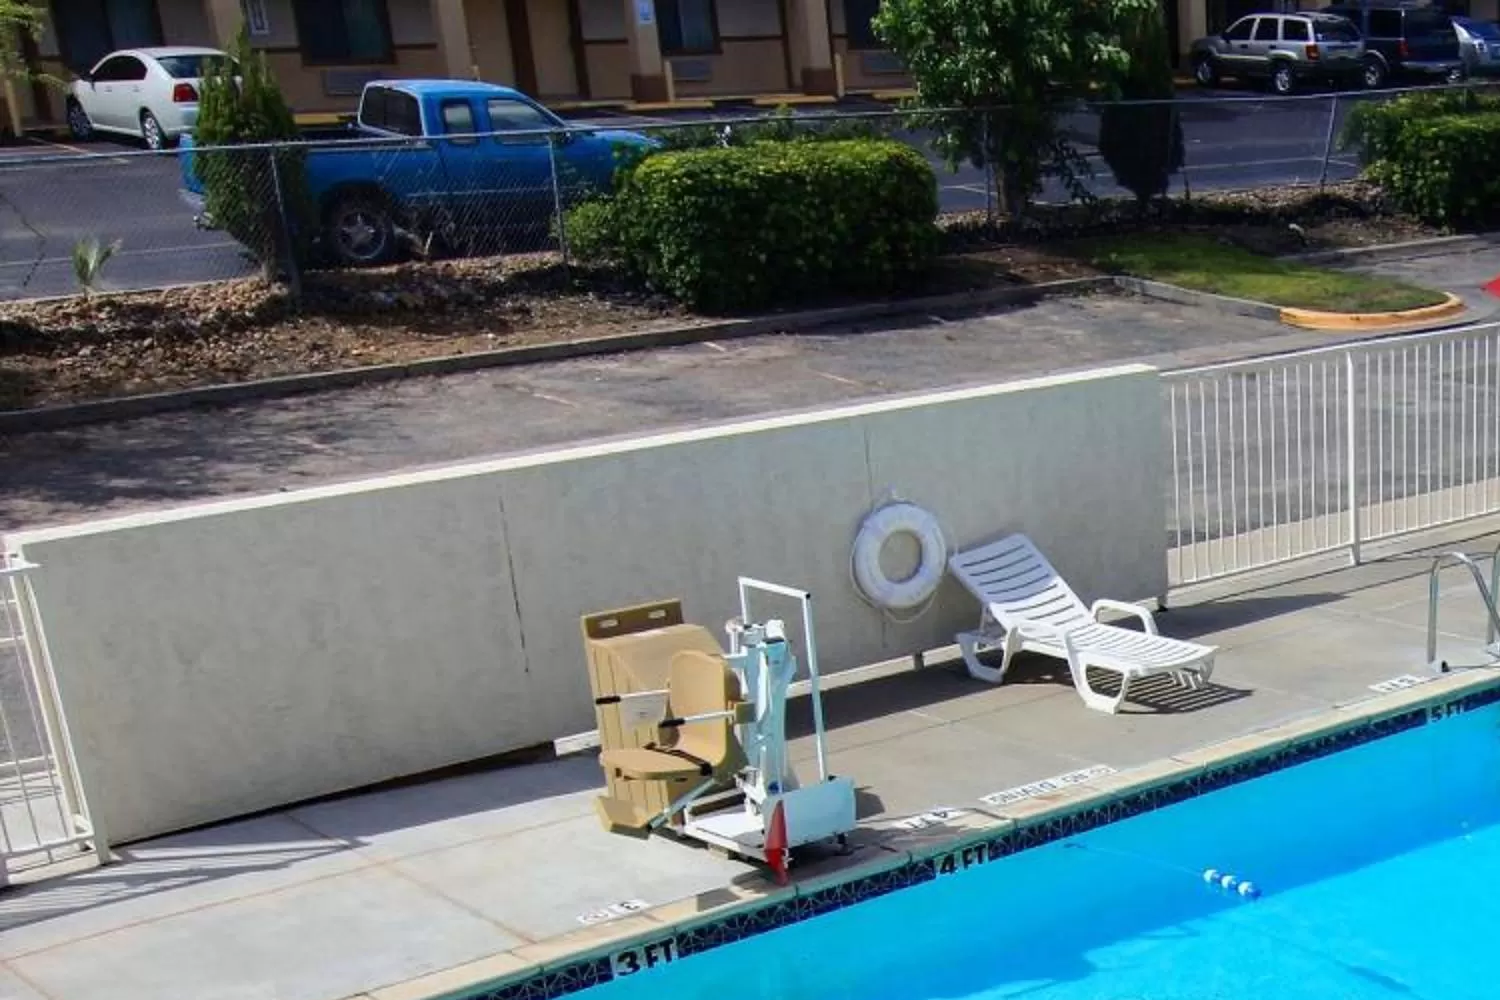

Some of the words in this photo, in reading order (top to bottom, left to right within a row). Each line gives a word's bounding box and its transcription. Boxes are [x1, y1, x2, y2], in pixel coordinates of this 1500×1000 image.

[939, 852, 960, 875] 4
[962, 843, 988, 871] FT
[617, 950, 641, 977] 3
[643, 937, 676, 969] FT
